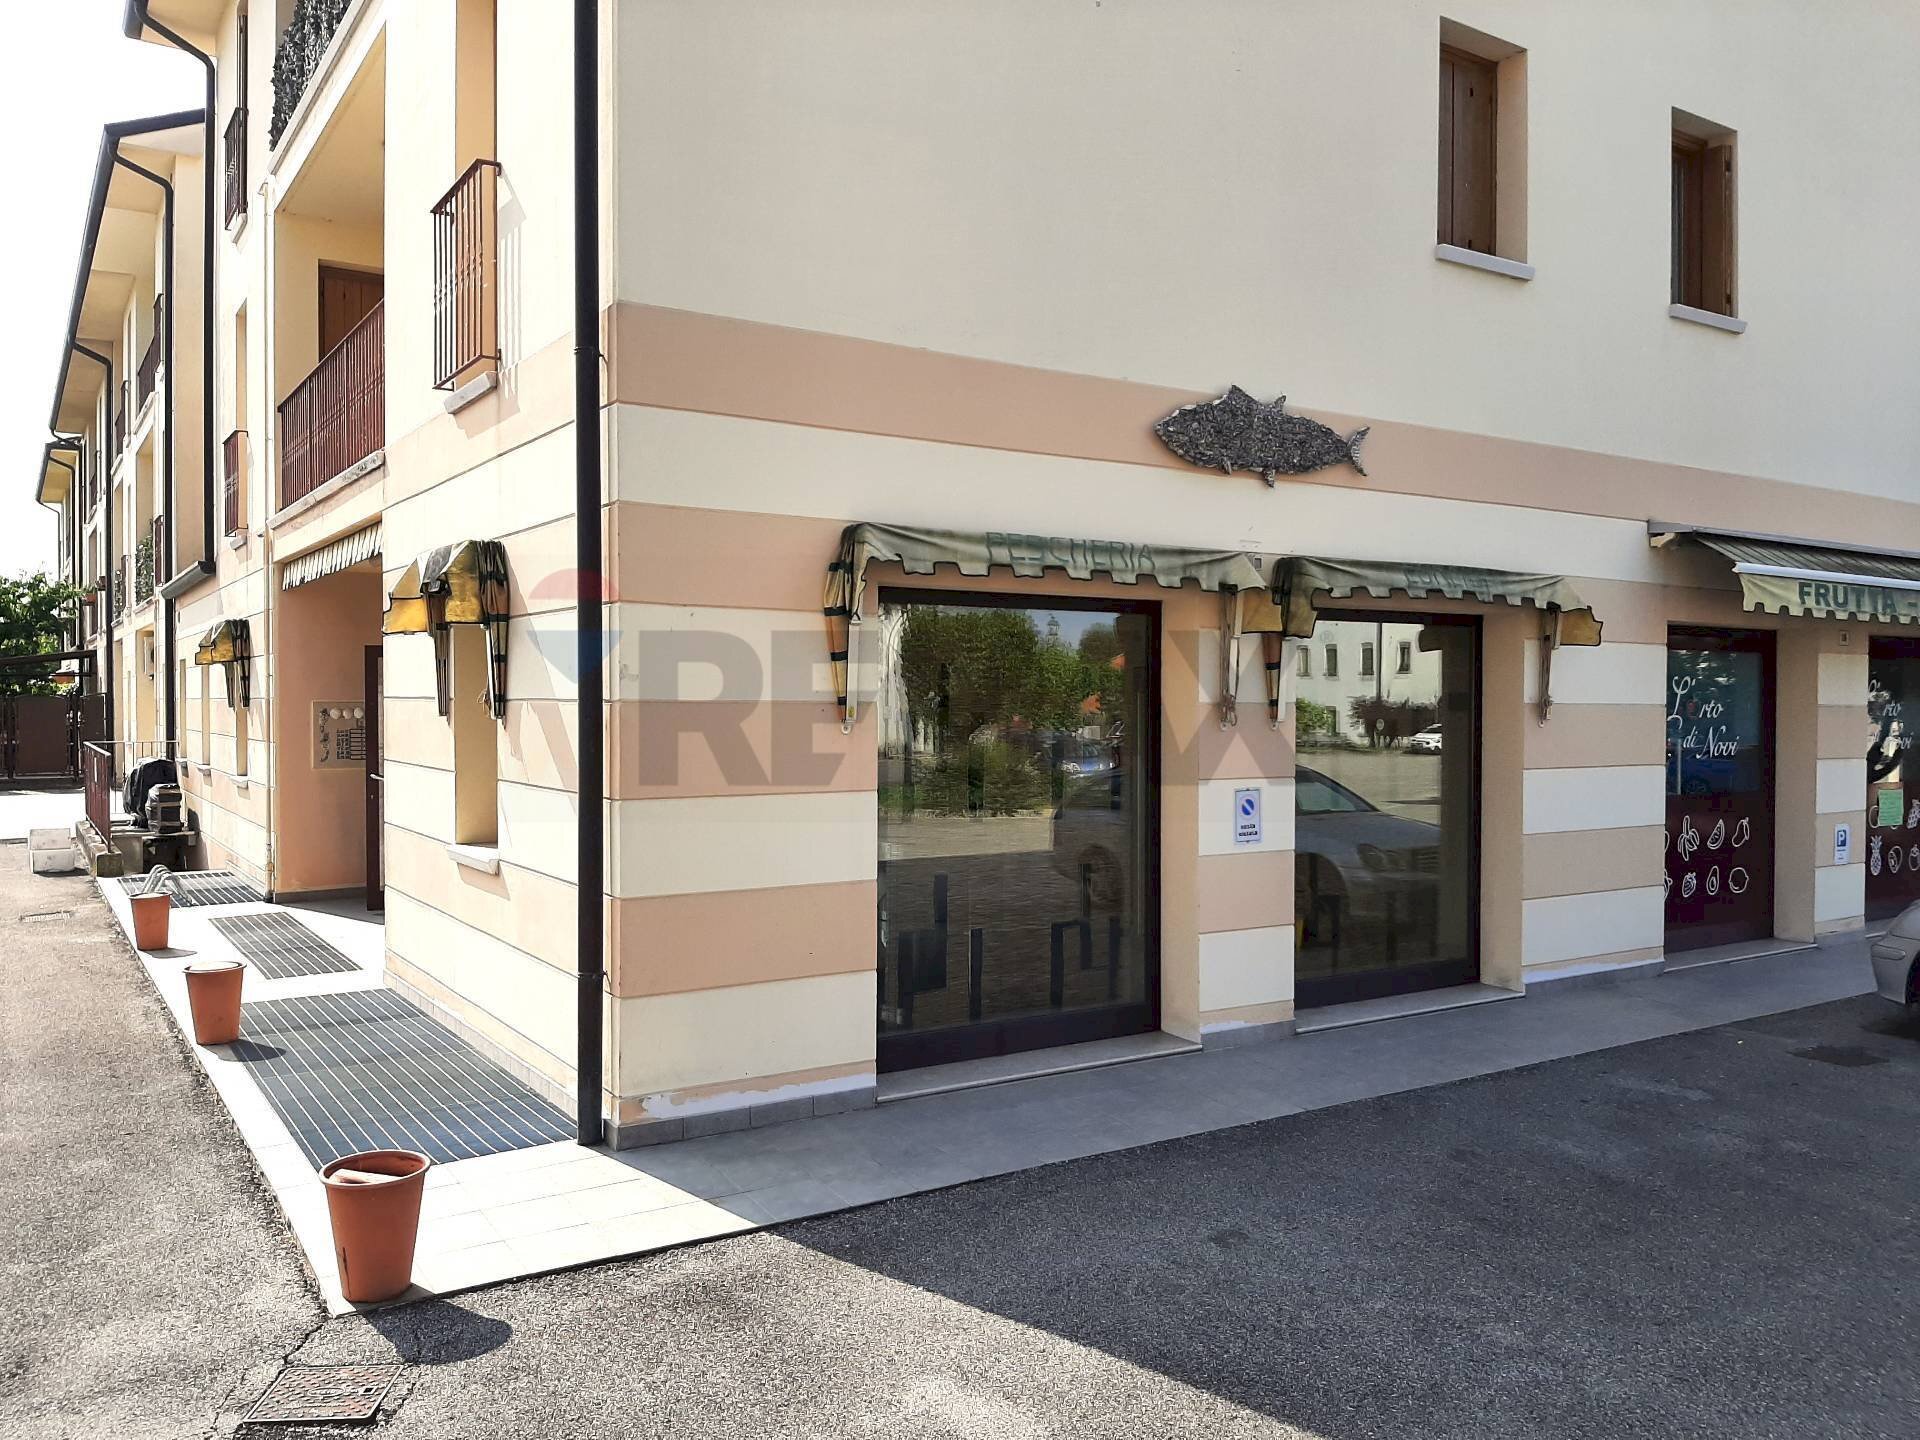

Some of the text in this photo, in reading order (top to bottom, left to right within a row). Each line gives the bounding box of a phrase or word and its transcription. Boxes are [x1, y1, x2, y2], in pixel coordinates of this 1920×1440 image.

[1798, 581, 1898, 616] FRUTTA
[1683, 725, 1741, 760] di Novi
